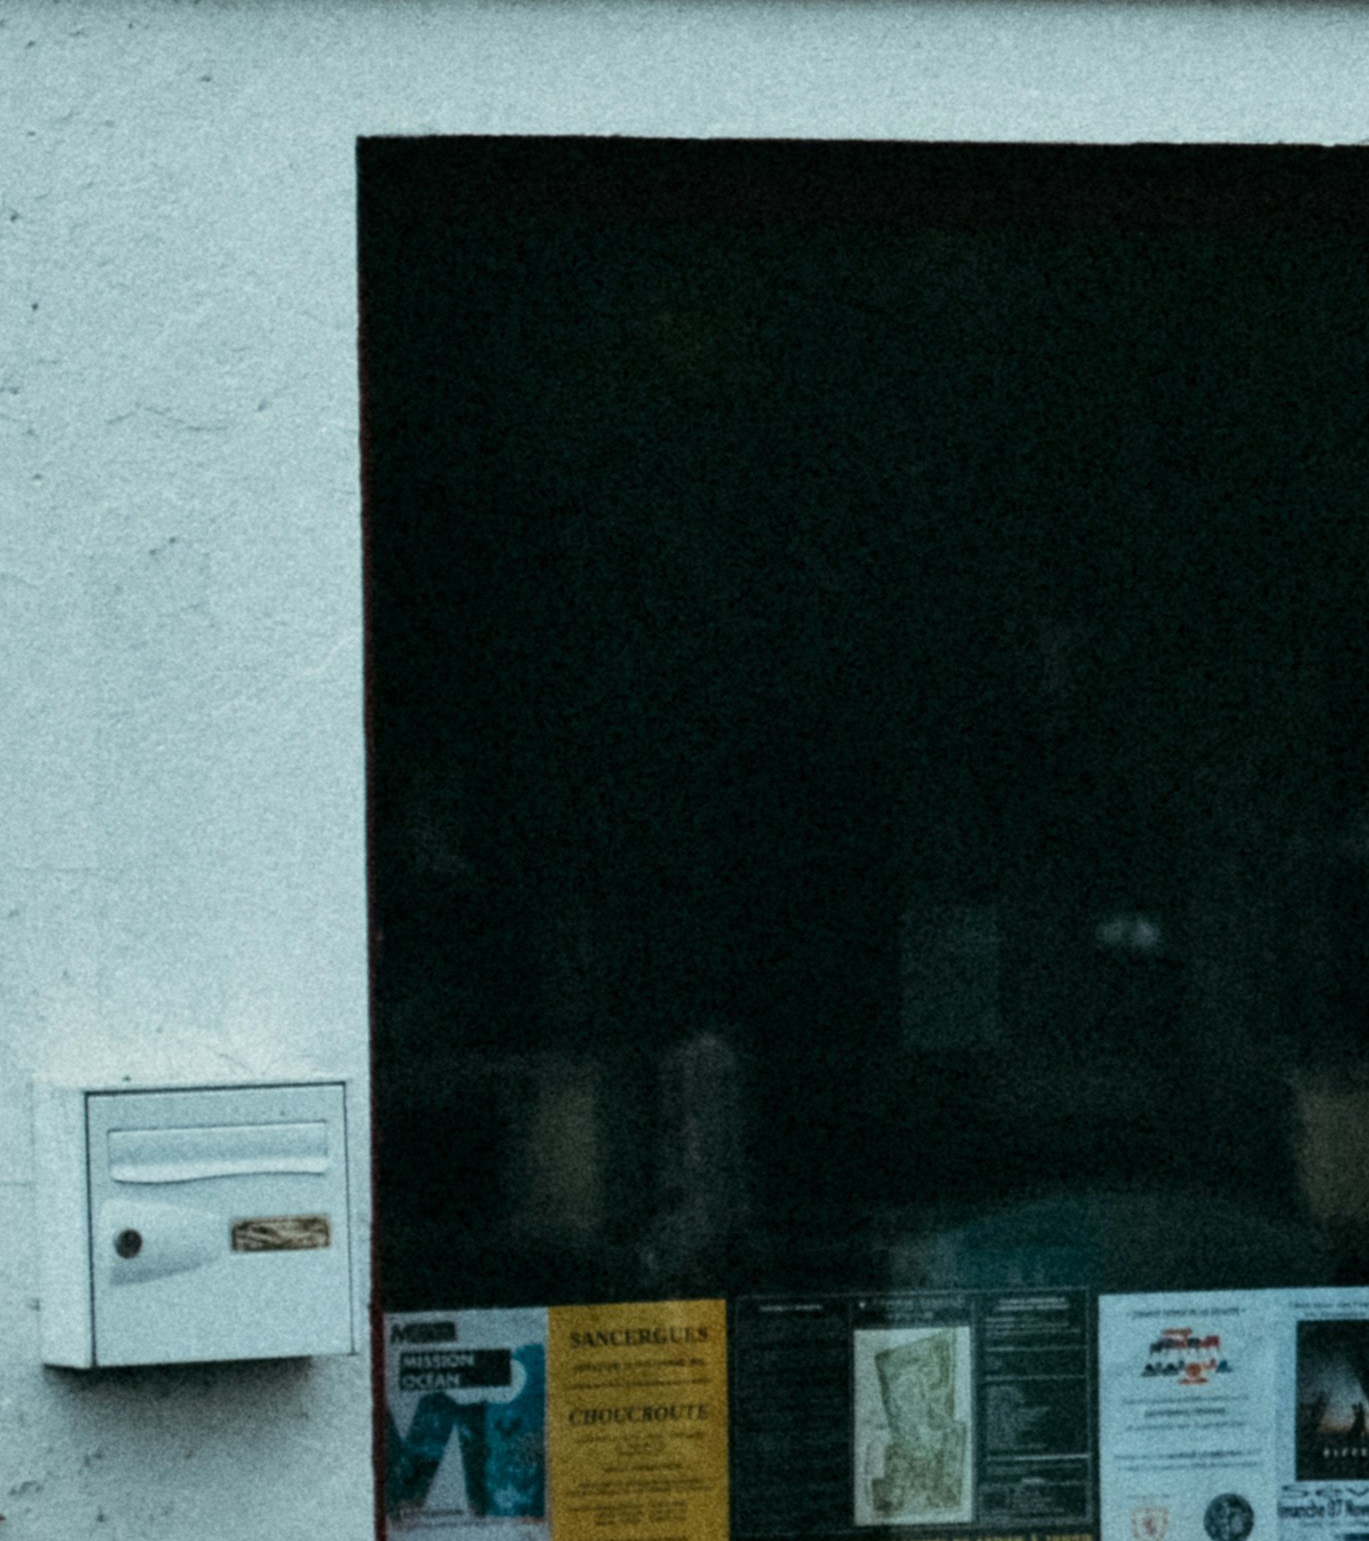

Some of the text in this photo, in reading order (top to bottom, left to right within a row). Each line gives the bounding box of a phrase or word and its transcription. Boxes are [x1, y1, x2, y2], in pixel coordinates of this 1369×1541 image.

[569, 1326, 710, 1349] SANCERGUES
[402, 1352, 475, 1369] MISSION
[568, 1403, 709, 1427] CHOUCROUTE
